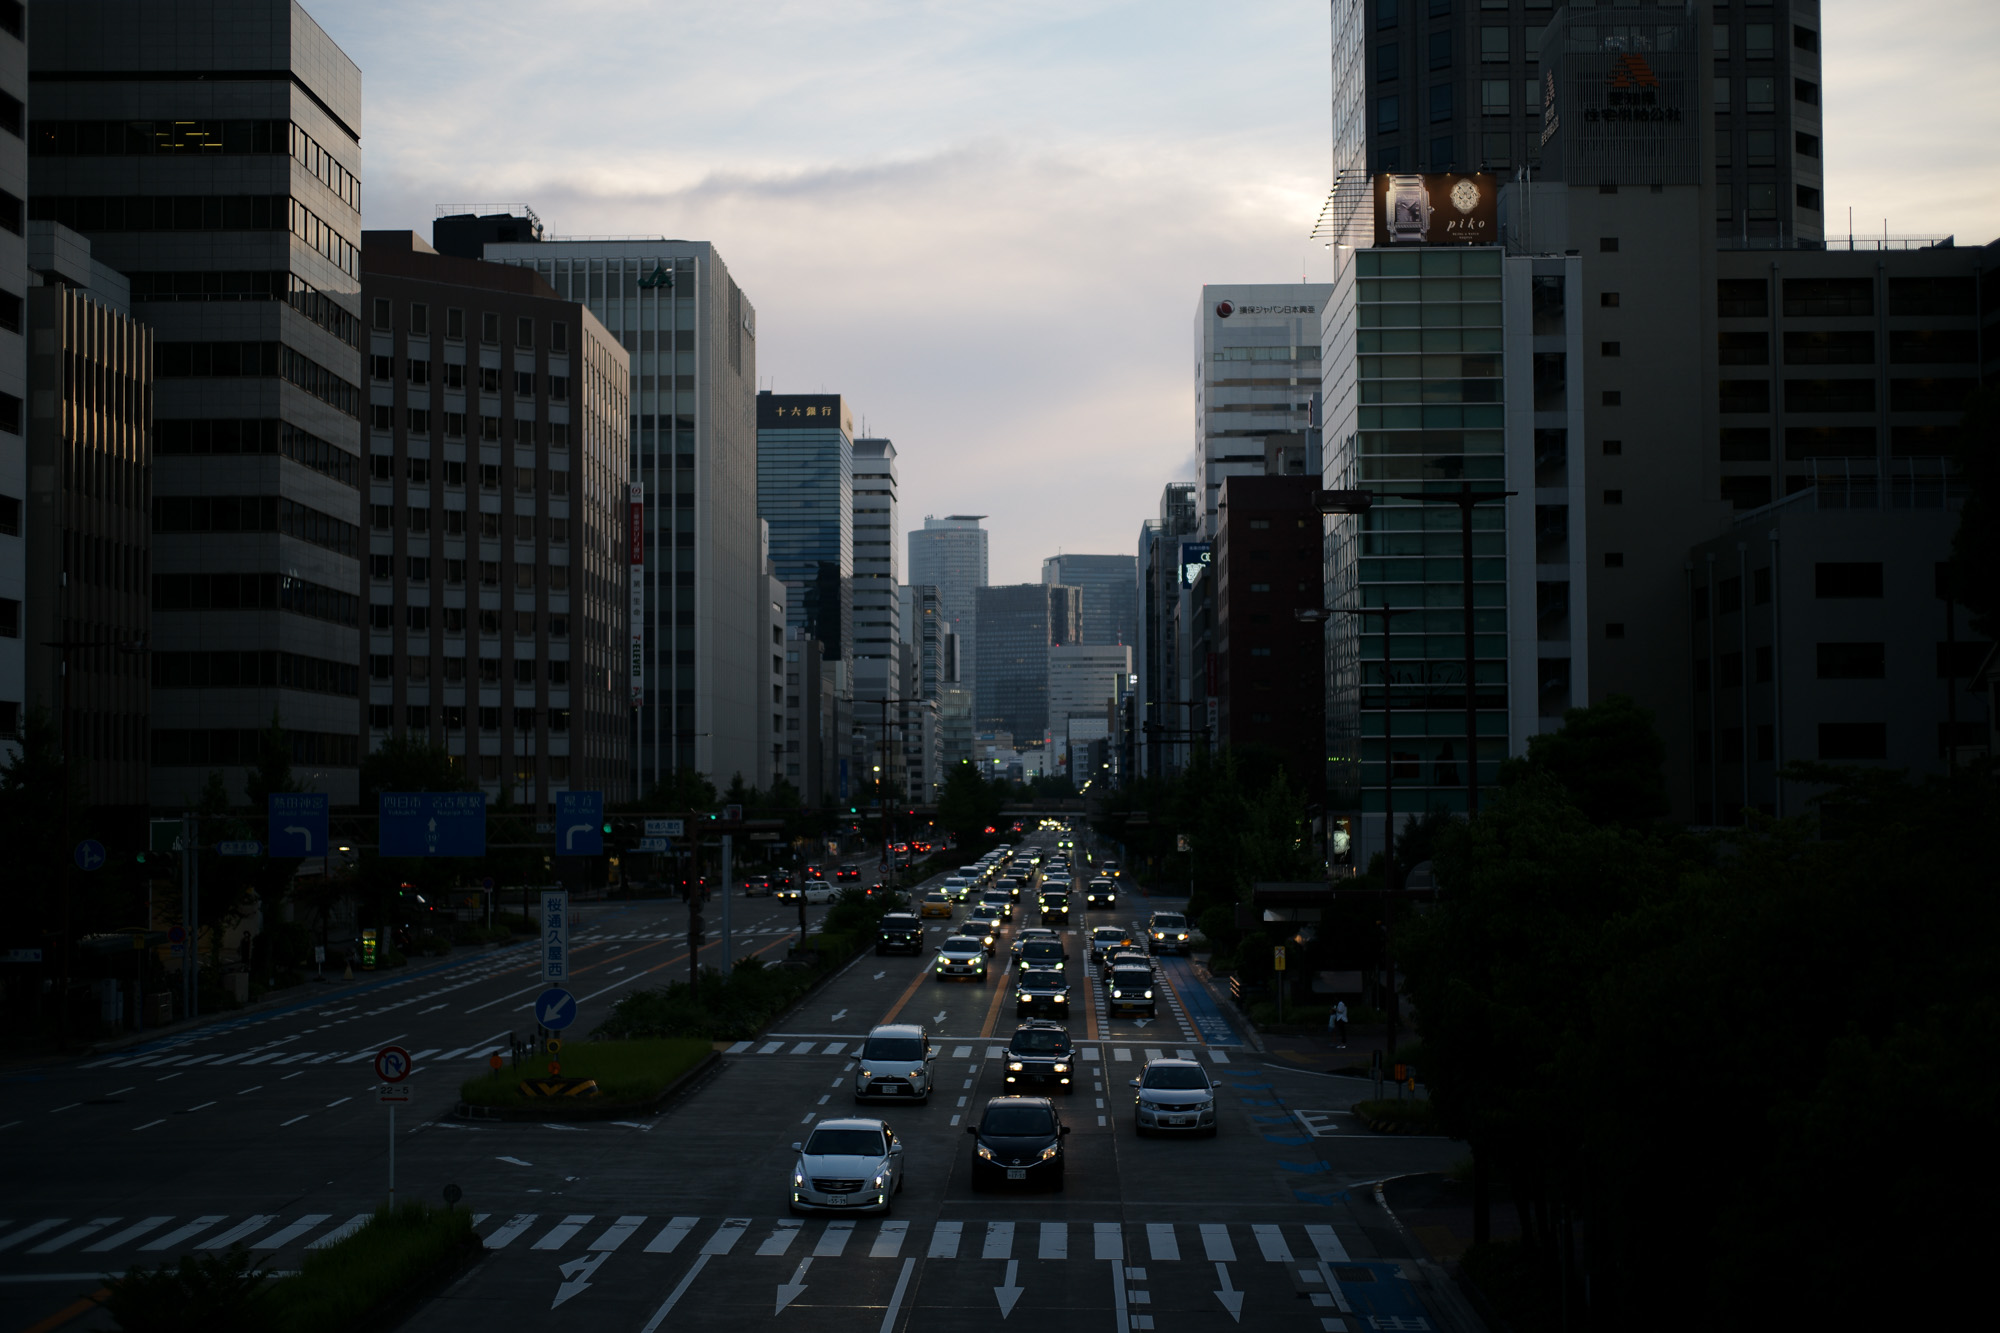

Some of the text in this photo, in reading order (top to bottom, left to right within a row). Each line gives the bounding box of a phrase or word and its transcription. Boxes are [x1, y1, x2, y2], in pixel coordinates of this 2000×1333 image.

[1446, 217, 1486, 232] piko
[1239, 305, 1315, 314] 損保ジャパン日本興亜
[776, 406, 832, 417] 十六銀行
[384, 795, 421, 808] 四日市
[432, 795, 481, 808] 名古屋駅
[547, 898, 562, 976] 桜通久屋西
[380, 1086, 409, 1095] 22-5
